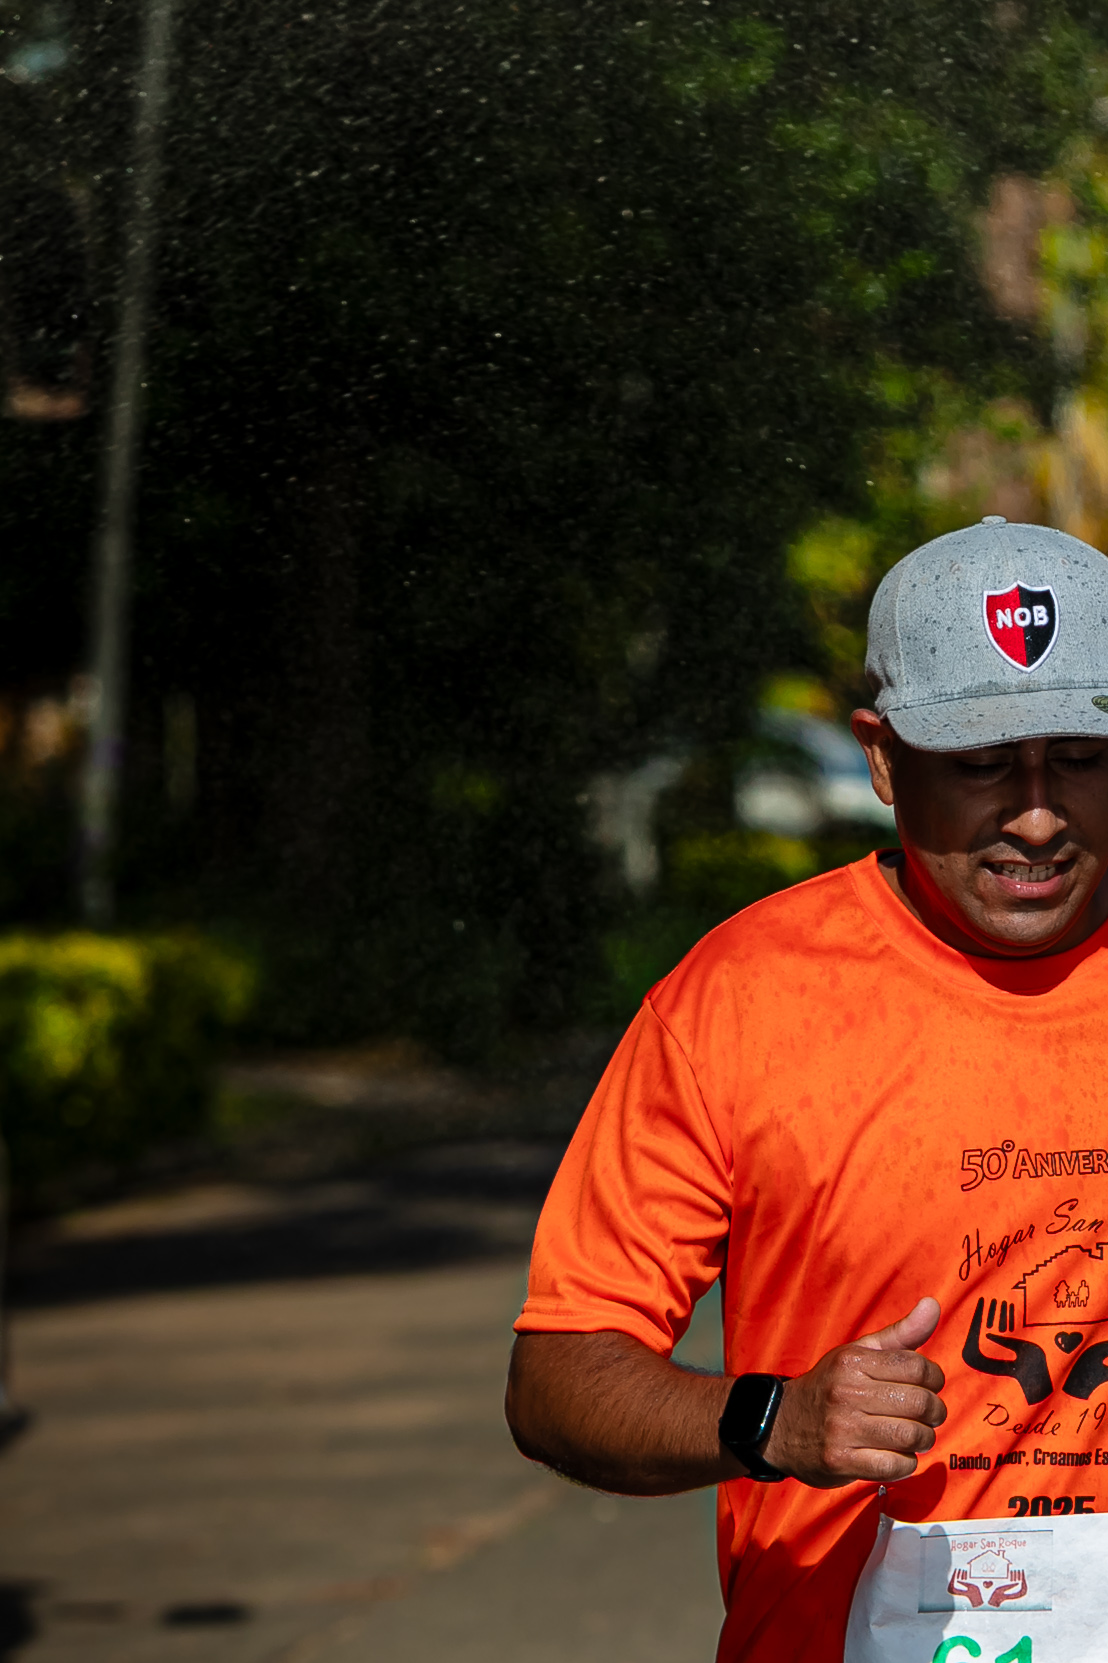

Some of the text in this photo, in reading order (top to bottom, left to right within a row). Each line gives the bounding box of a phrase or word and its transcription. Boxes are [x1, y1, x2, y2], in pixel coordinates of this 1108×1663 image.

[996, 605, 1049, 629] NOB
[959, 1224, 1035, 1281] Hogar
[1045, 1198, 1105, 1235] San
[982, 1402, 1062, 1436] Desde
[949, 1453, 991, 1471] Dando
[1033, 1447, 1092, 1468] Creamos
[950, 1537, 1027, 1552] Hogar San Roque
